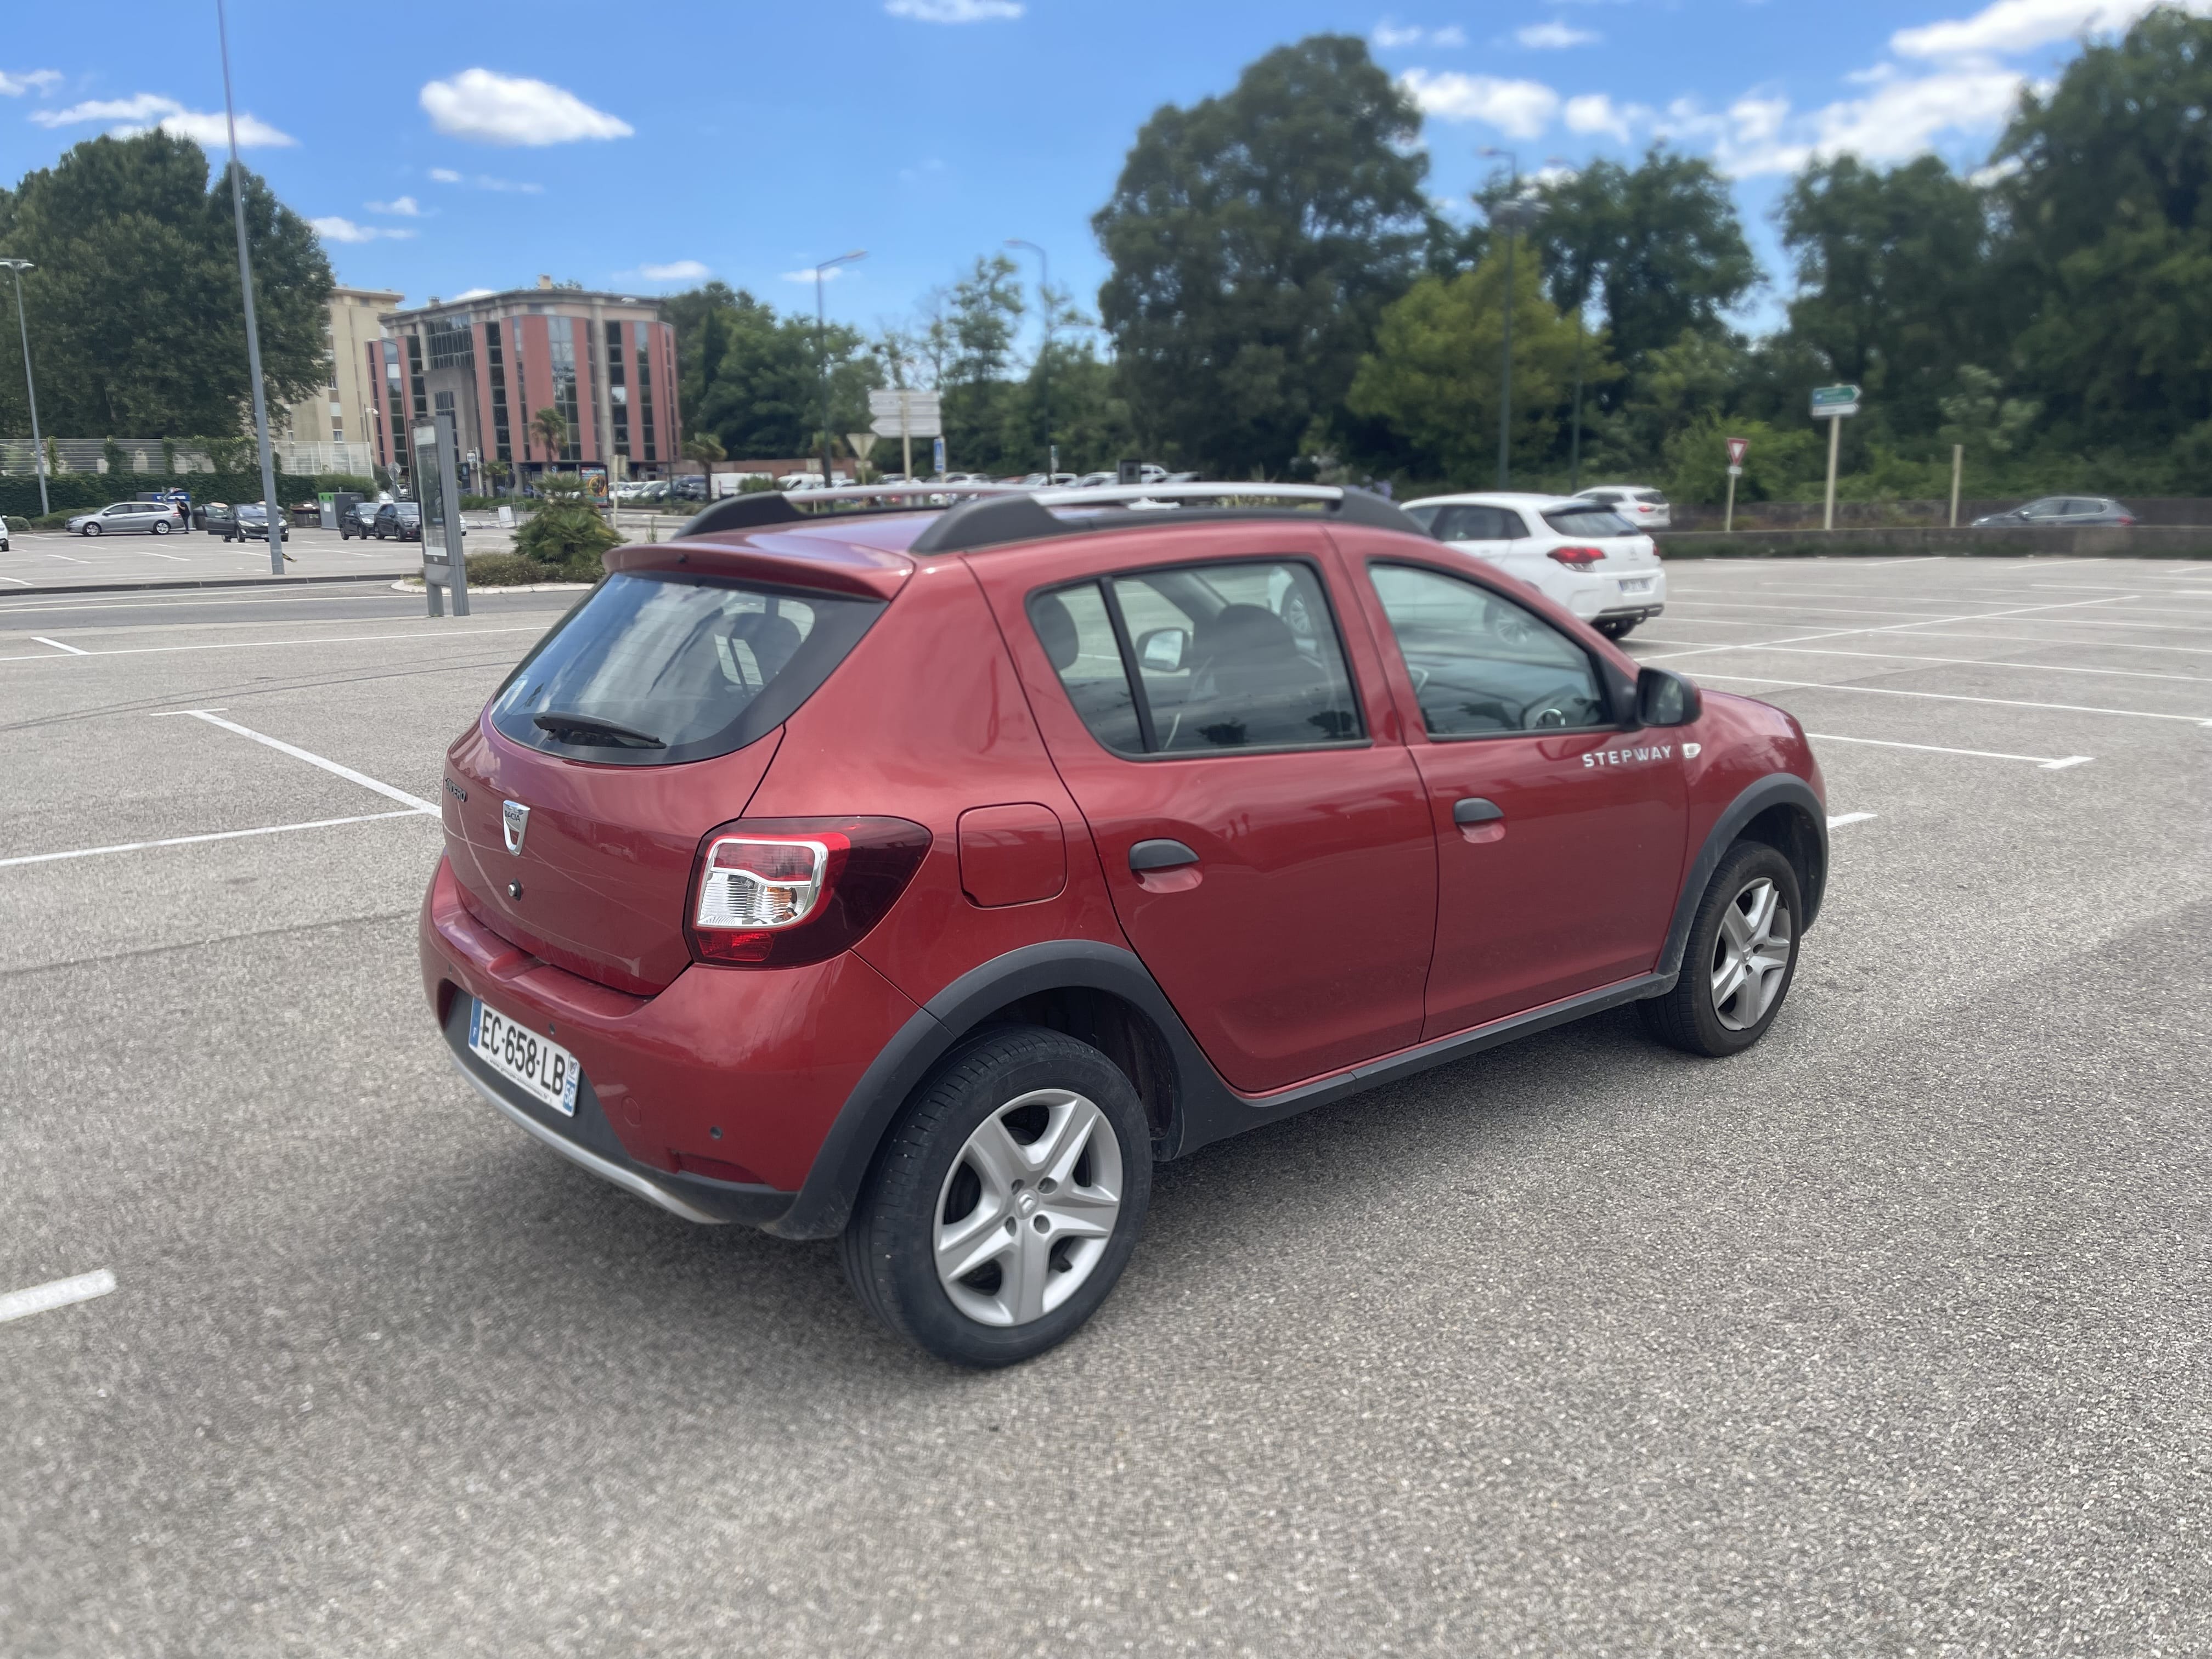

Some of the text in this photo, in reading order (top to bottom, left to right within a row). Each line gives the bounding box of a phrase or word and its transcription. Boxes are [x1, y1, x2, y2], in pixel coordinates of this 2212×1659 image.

[1582, 746, 1671, 767] STEPWAY
[505, 810, 520, 822] DACIA
[565, 1083, 574, 1107] 58
